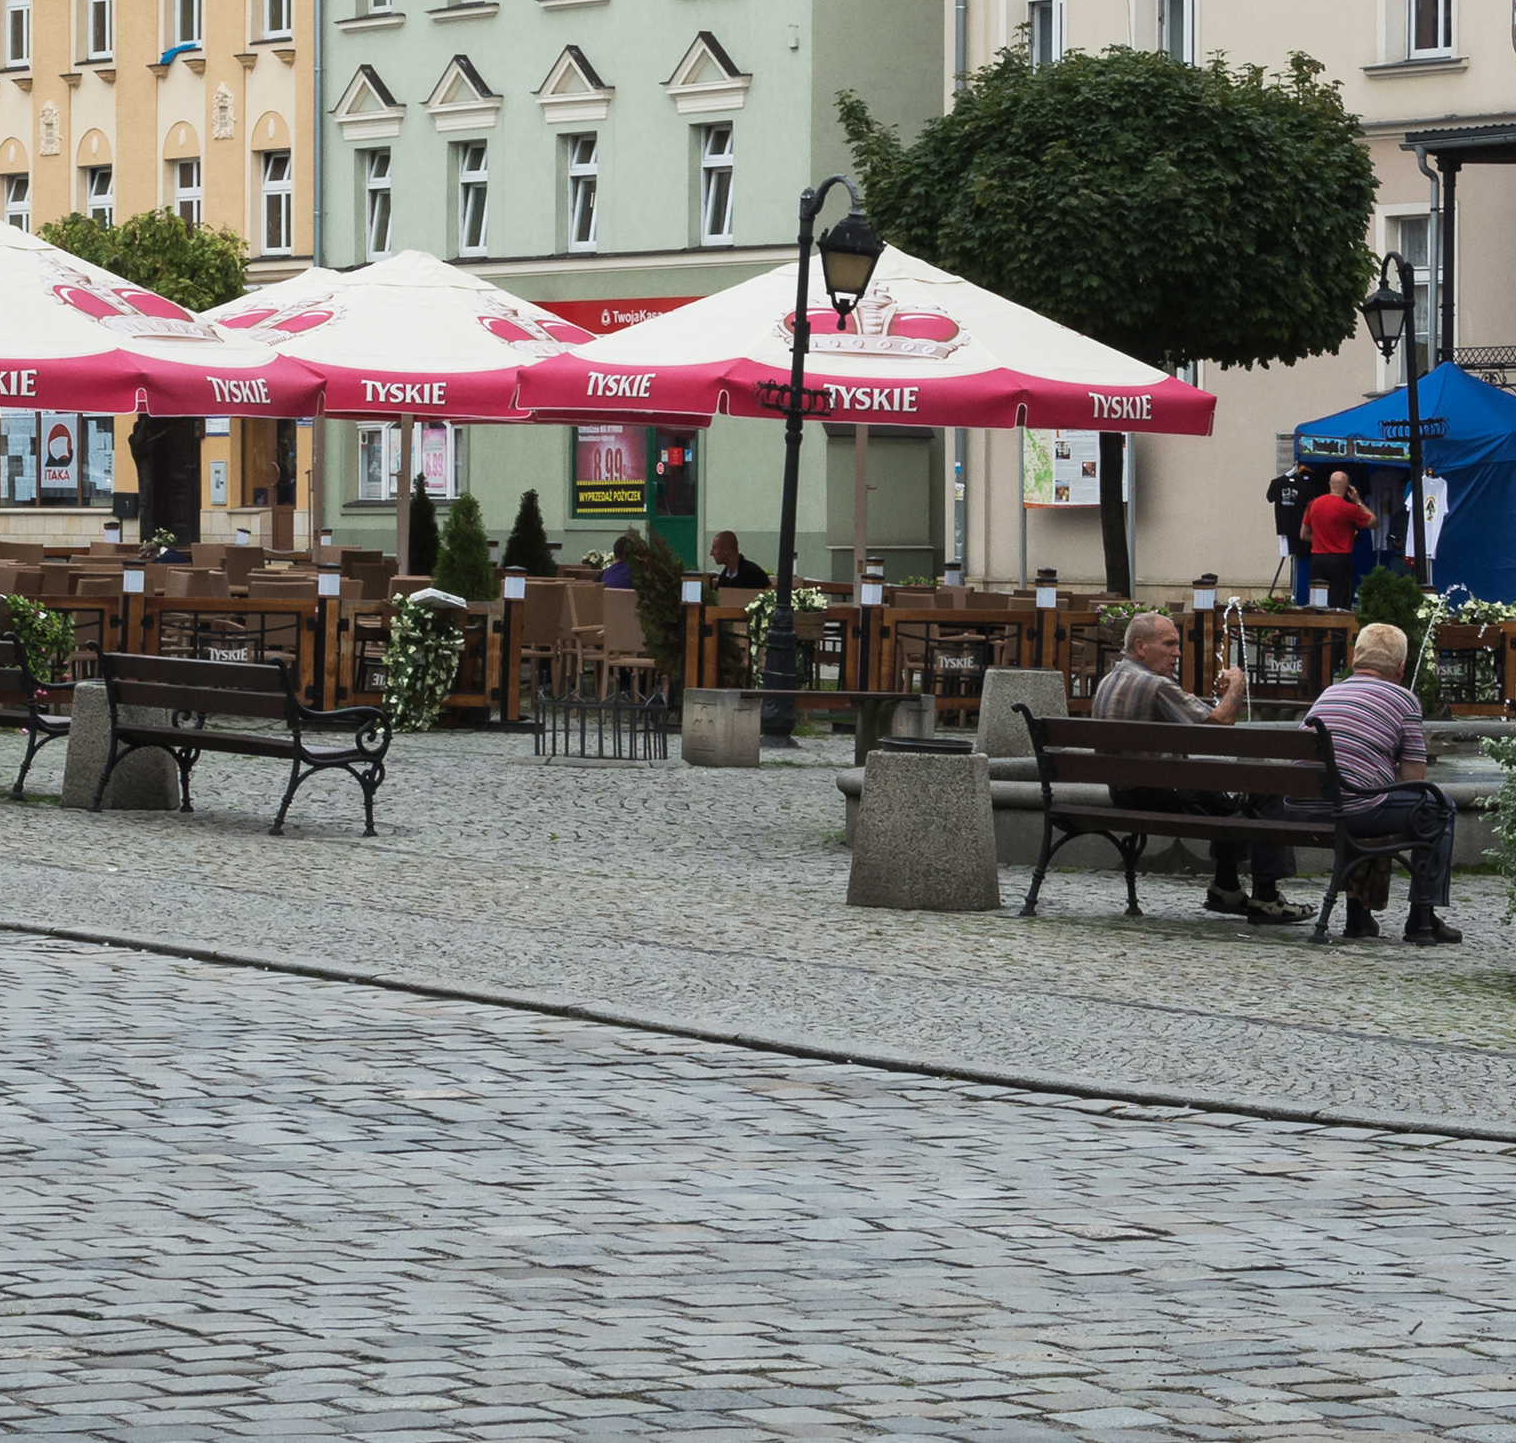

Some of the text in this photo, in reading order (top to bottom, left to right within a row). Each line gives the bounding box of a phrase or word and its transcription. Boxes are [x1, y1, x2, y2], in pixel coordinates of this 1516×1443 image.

[205, 376, 271, 404] TYSKIE
[361, 379, 447, 405] TYSKIE
[587, 372, 656, 398] TYSKIE
[823, 383, 919, 413] TYSKIE
[1088, 392, 1152, 420] TYSKIE
[44, 468, 70, 481] ITAKA
[593, 447, 623, 480] 899
[579, 488, 642, 502] WYPRZEDAŻ POŻYCZEK
[208, 647, 248, 661] TYSKIE
[938, 656, 974, 668] TYSKIE
[1269, 659, 1303, 672] TYSKIE
